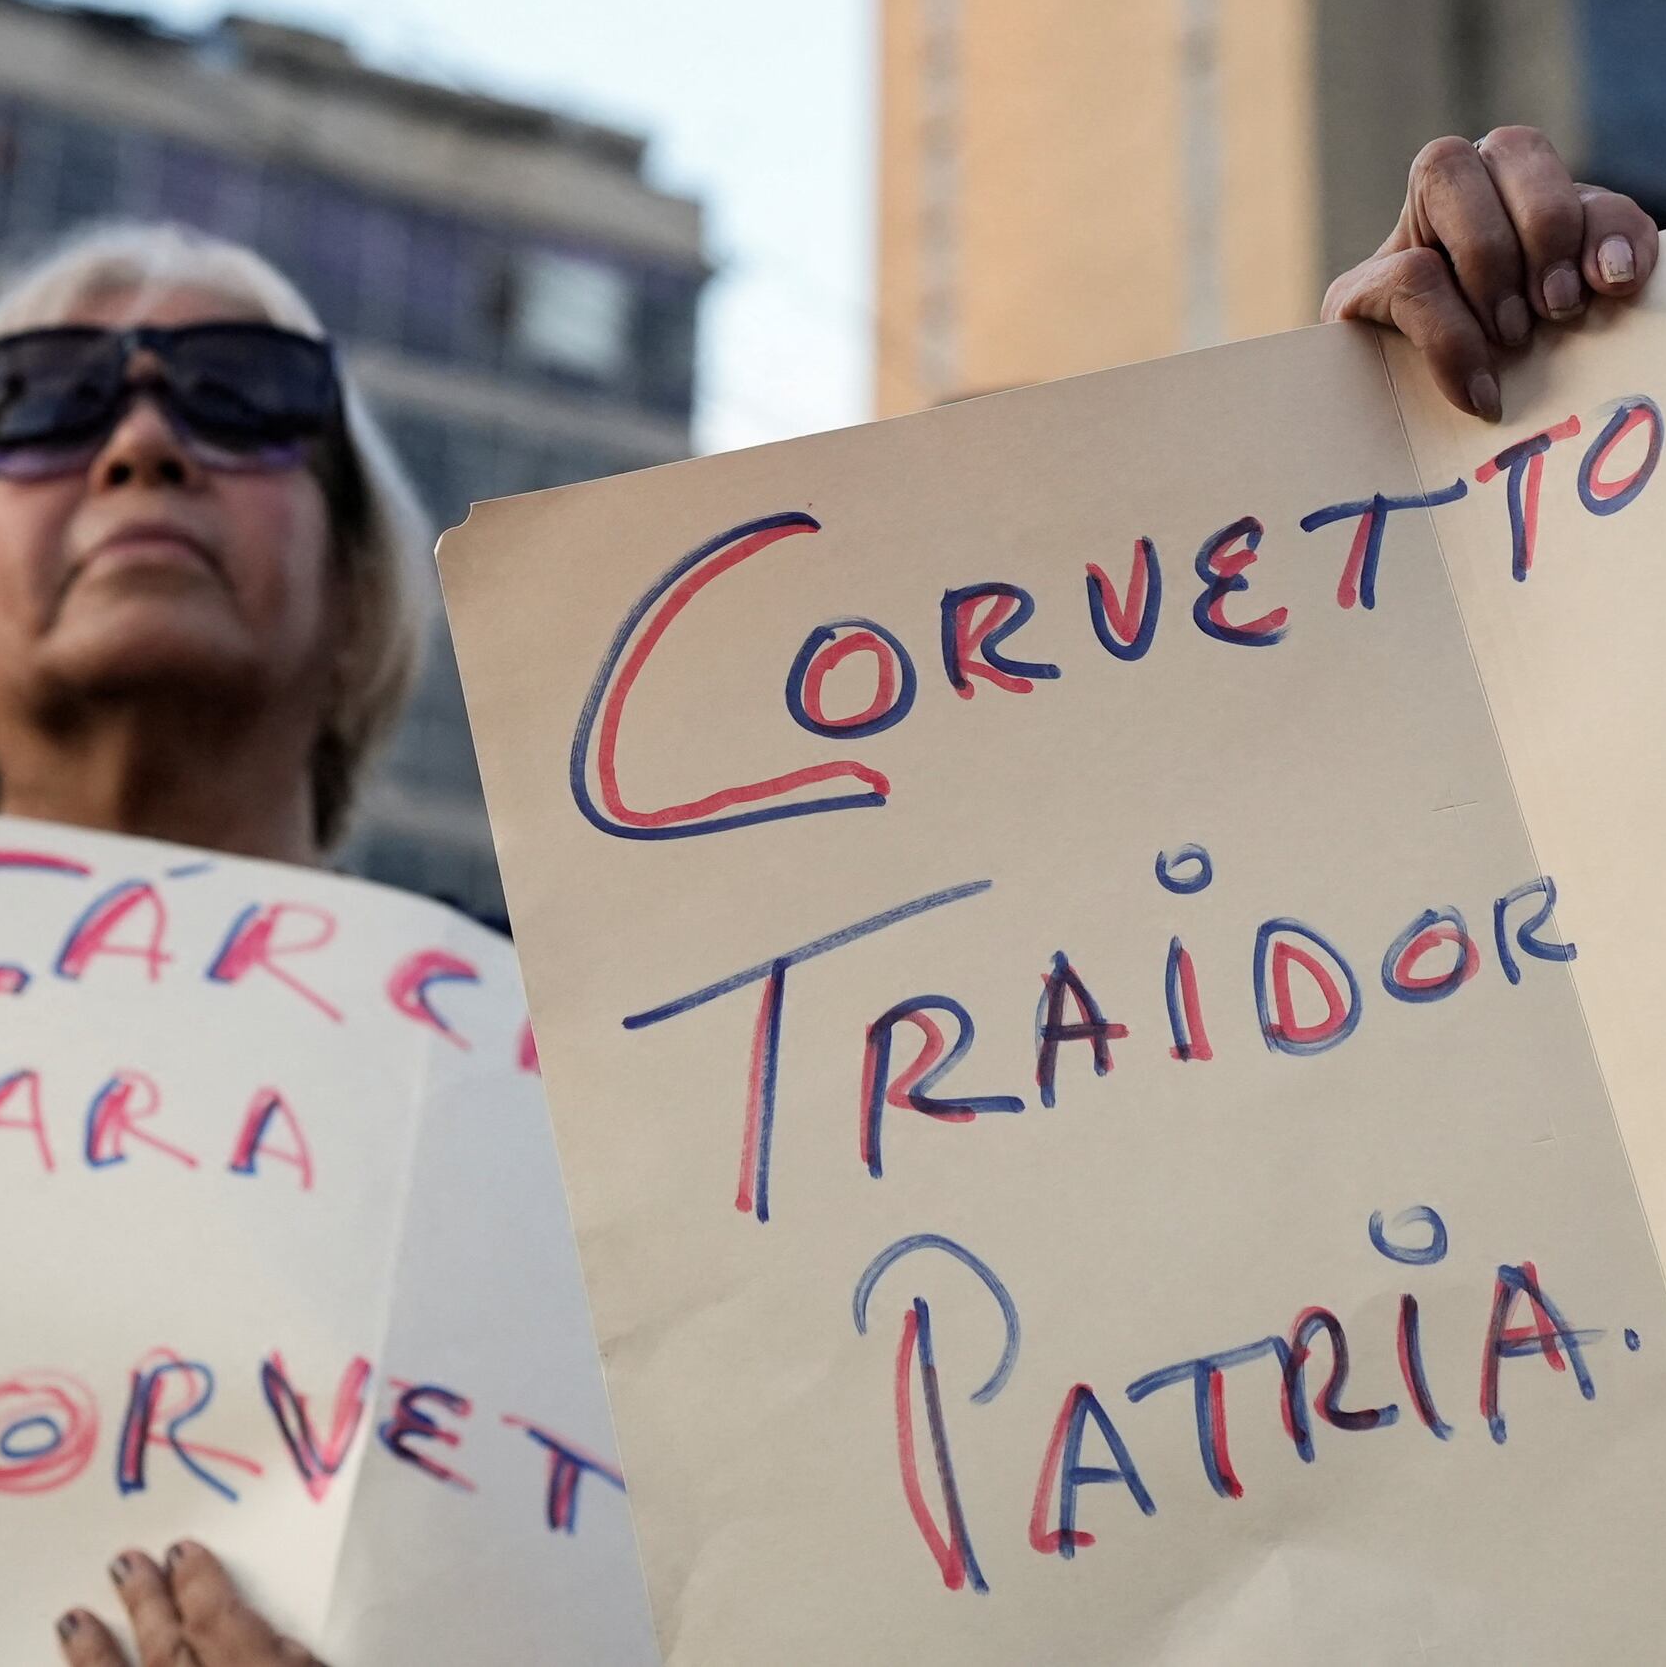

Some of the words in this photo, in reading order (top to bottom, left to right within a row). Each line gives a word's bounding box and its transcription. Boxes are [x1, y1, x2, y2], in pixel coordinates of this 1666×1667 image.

[570, 394, 1666, 840] CORVETTO
[622, 843, 1577, 1222] TRAIDOR
[852, 1205, 1642, 1594] PATRIA.
